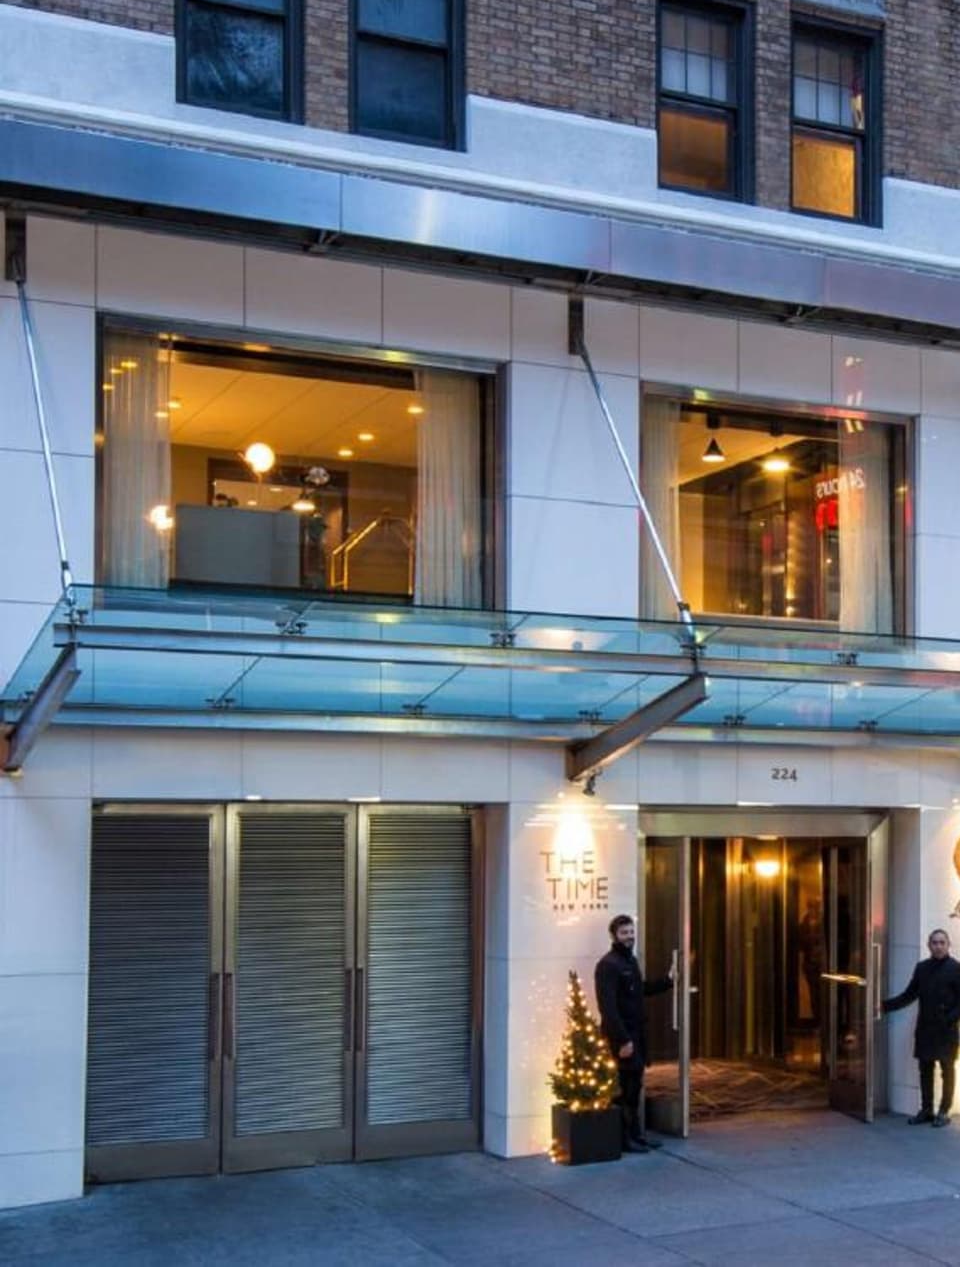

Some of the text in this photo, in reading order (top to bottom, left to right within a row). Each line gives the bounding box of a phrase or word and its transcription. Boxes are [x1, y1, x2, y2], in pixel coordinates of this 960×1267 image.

[771, 767, 798, 783] 224
[540, 850, 595, 874] THE
[546, 877, 609, 900] TIME
